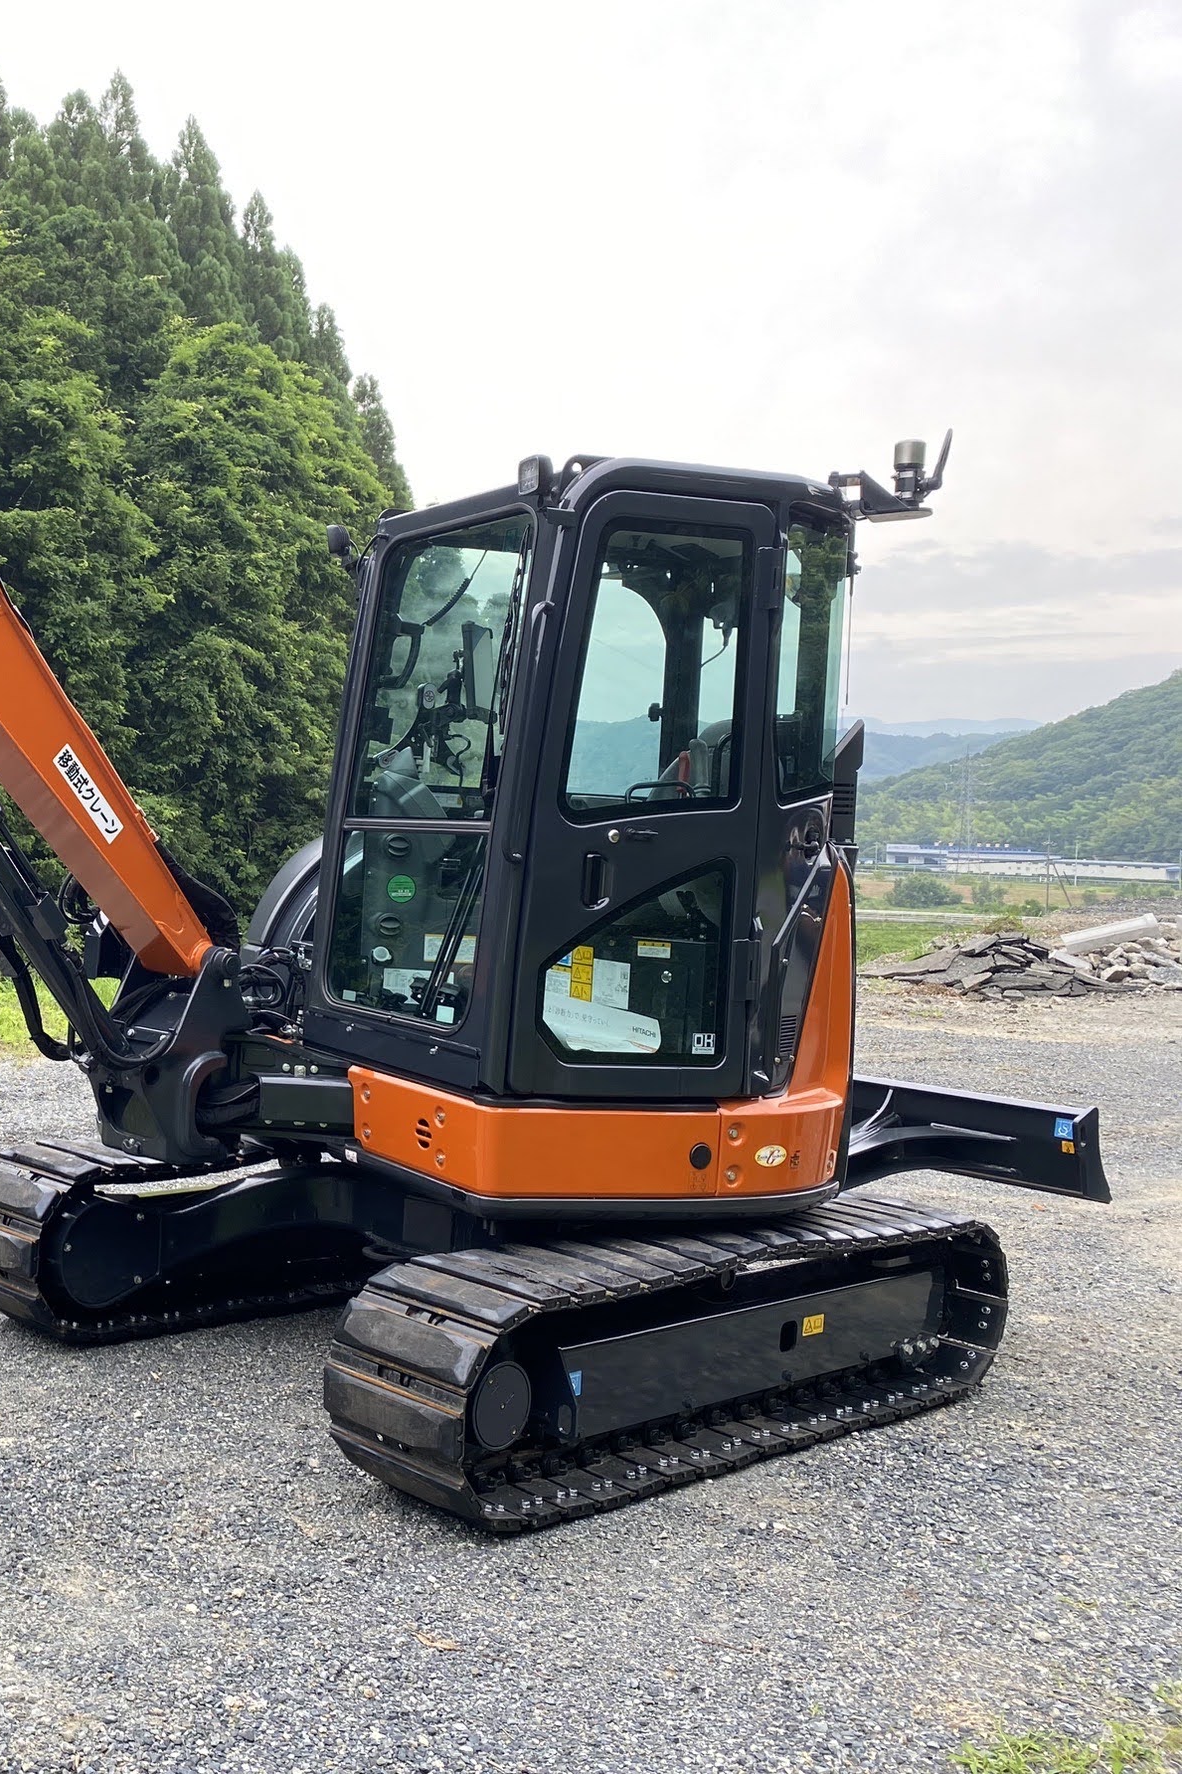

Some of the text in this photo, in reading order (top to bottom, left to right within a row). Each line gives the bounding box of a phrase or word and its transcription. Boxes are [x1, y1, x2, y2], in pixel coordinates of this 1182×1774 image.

[57, 748, 119, 834] 移動式クレーン
[632, 1026, 656, 1038] HITACHI
